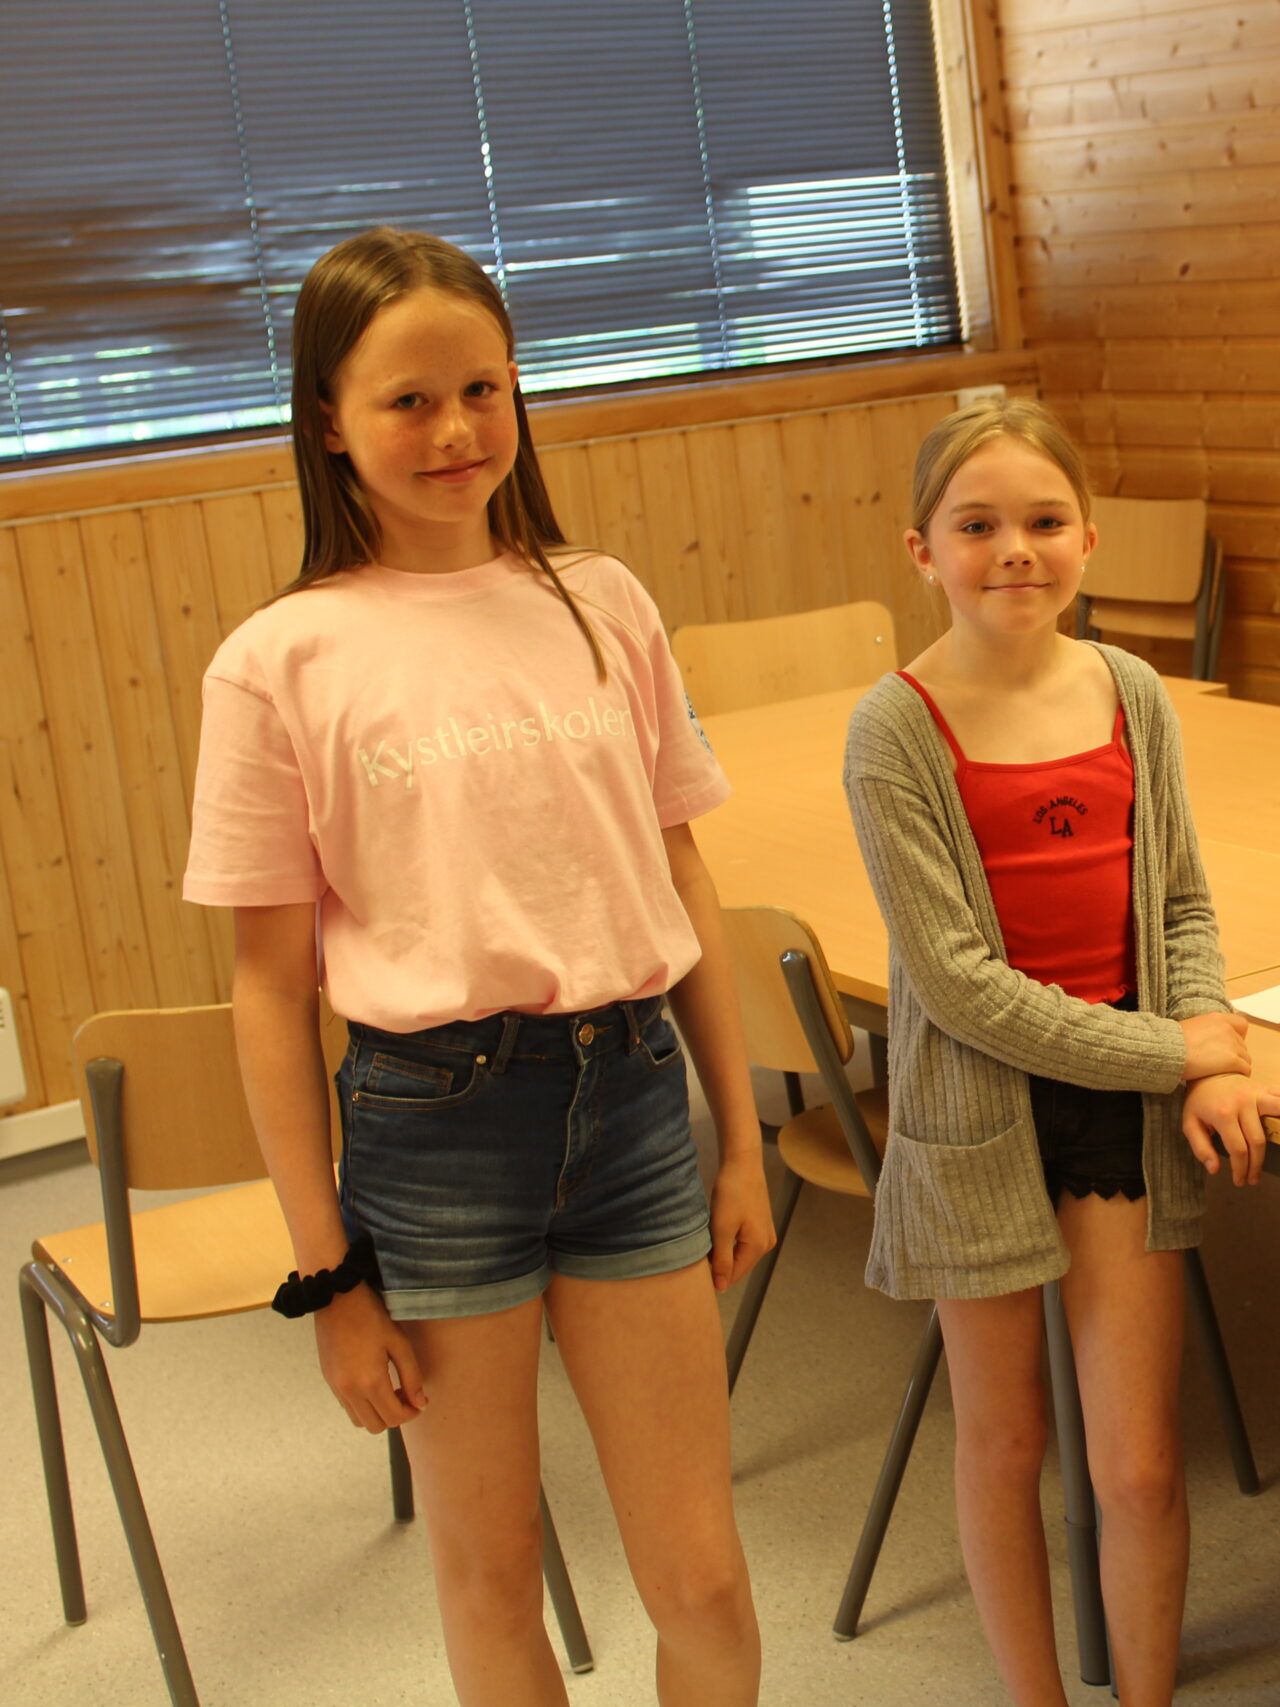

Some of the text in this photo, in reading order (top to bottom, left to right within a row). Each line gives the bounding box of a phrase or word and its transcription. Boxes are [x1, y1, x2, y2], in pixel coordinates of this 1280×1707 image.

[358, 697, 637, 789] Kystleirskolen
[1032, 796, 1089, 824] LOS ANGELES
[1049, 816, 1074, 838] LA
